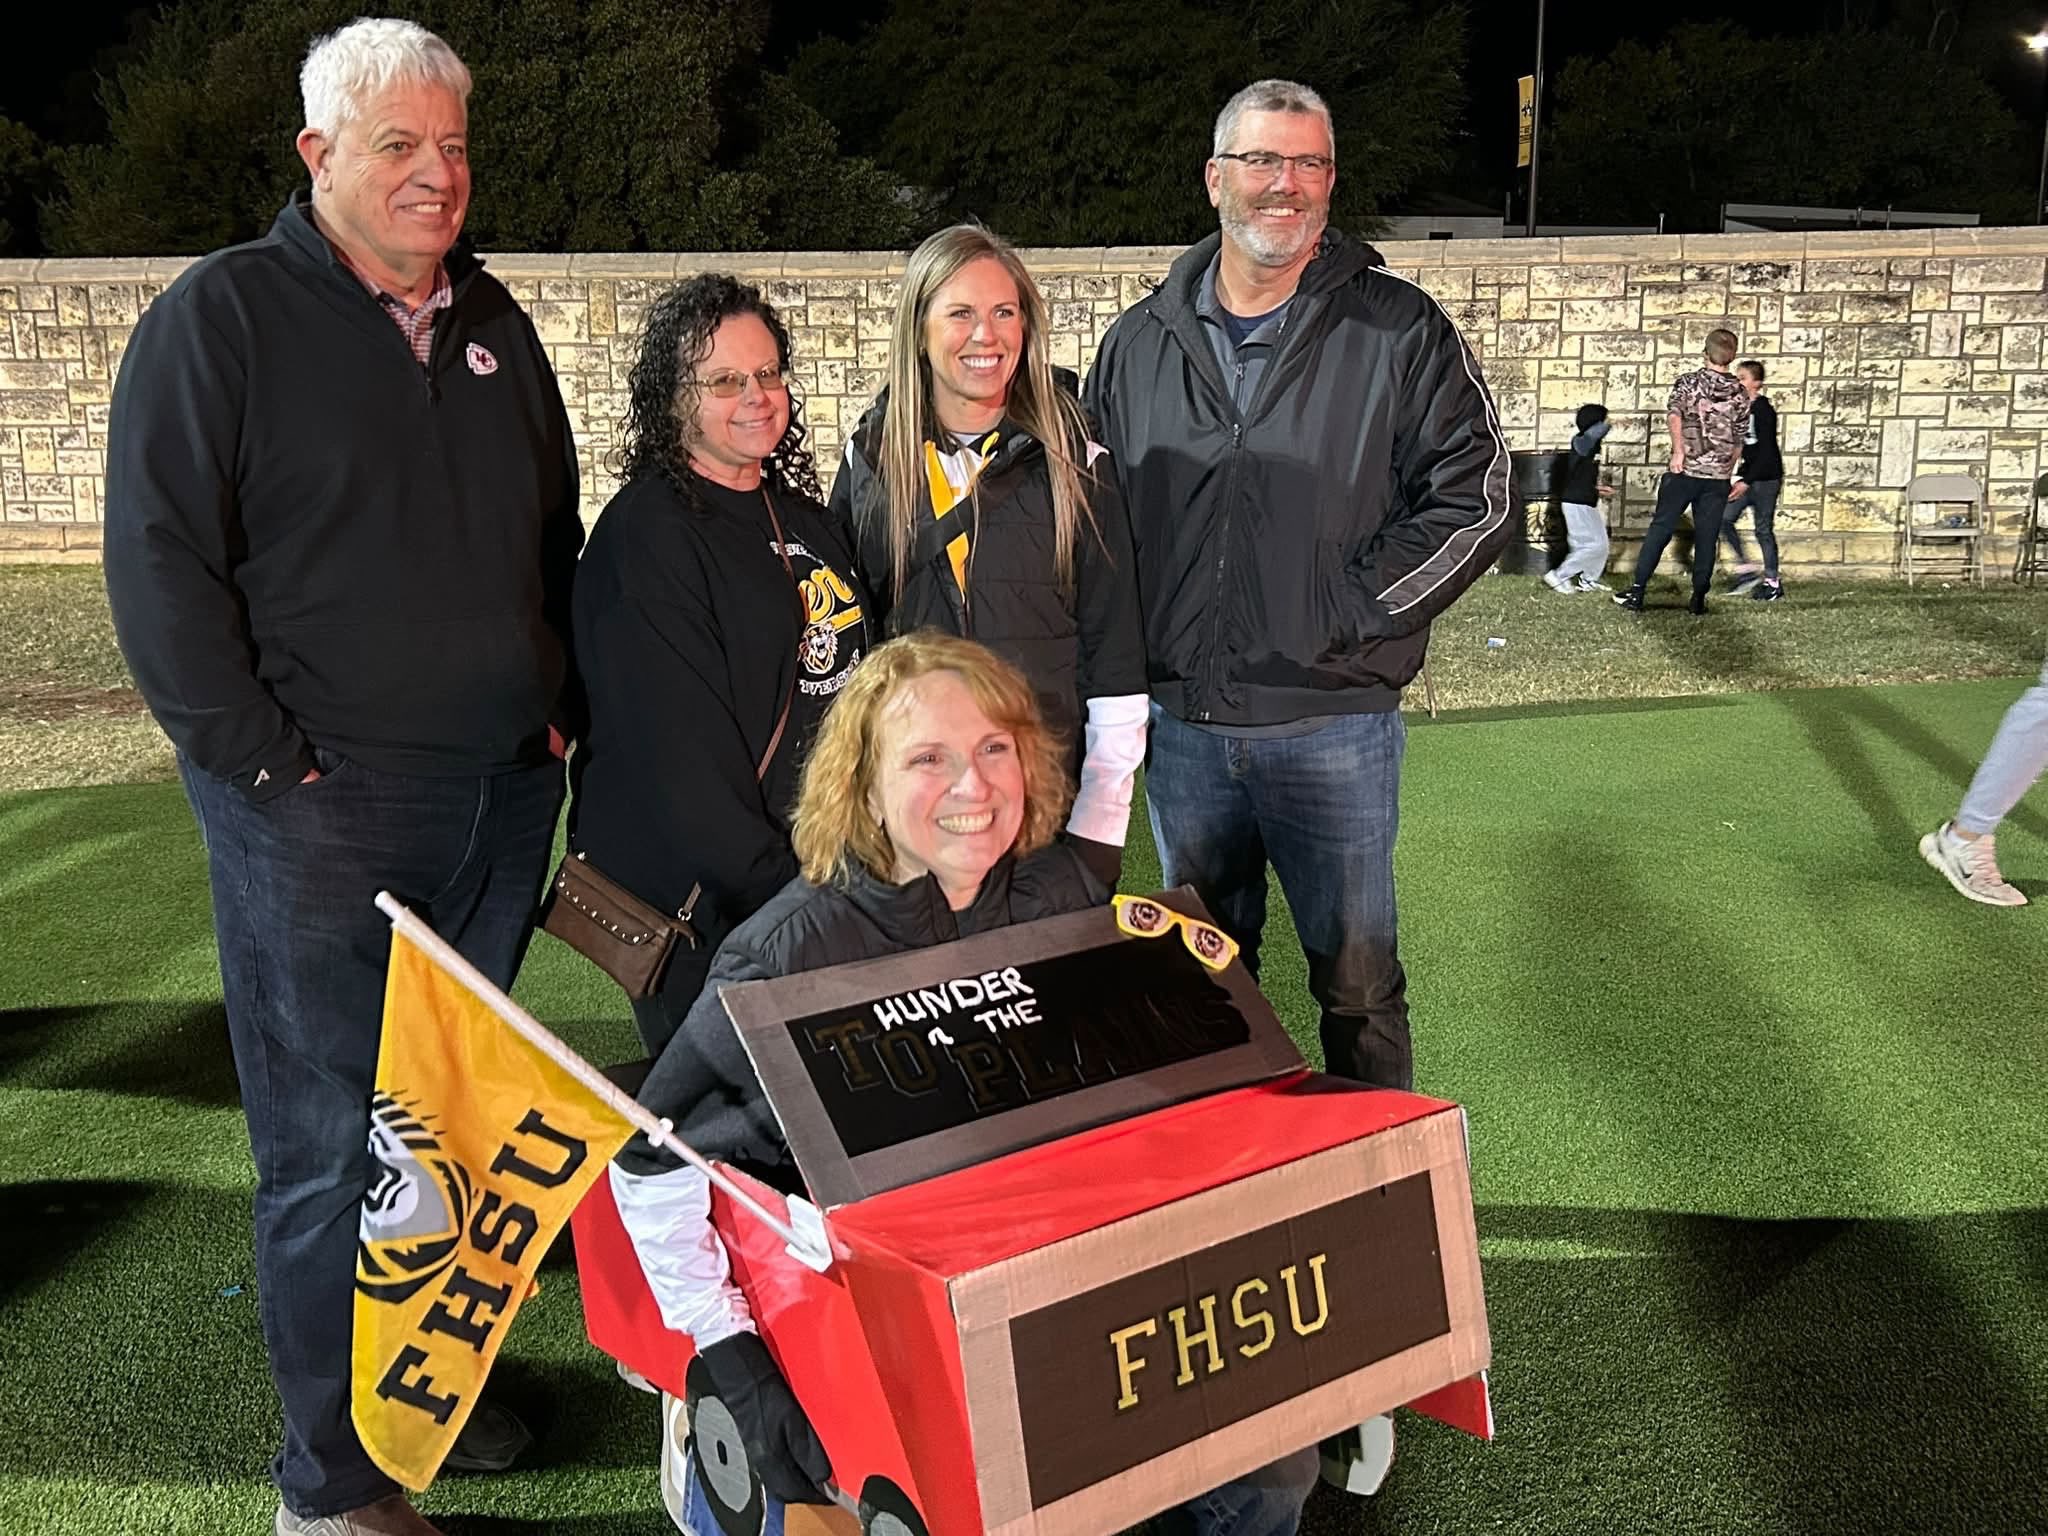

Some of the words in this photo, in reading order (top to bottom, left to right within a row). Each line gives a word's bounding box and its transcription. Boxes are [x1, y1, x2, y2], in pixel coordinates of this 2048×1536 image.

[973, 998, 1043, 1033] THE
[376, 1107, 590, 1425] FHSU
[1110, 1254, 1328, 1409] FHSU
